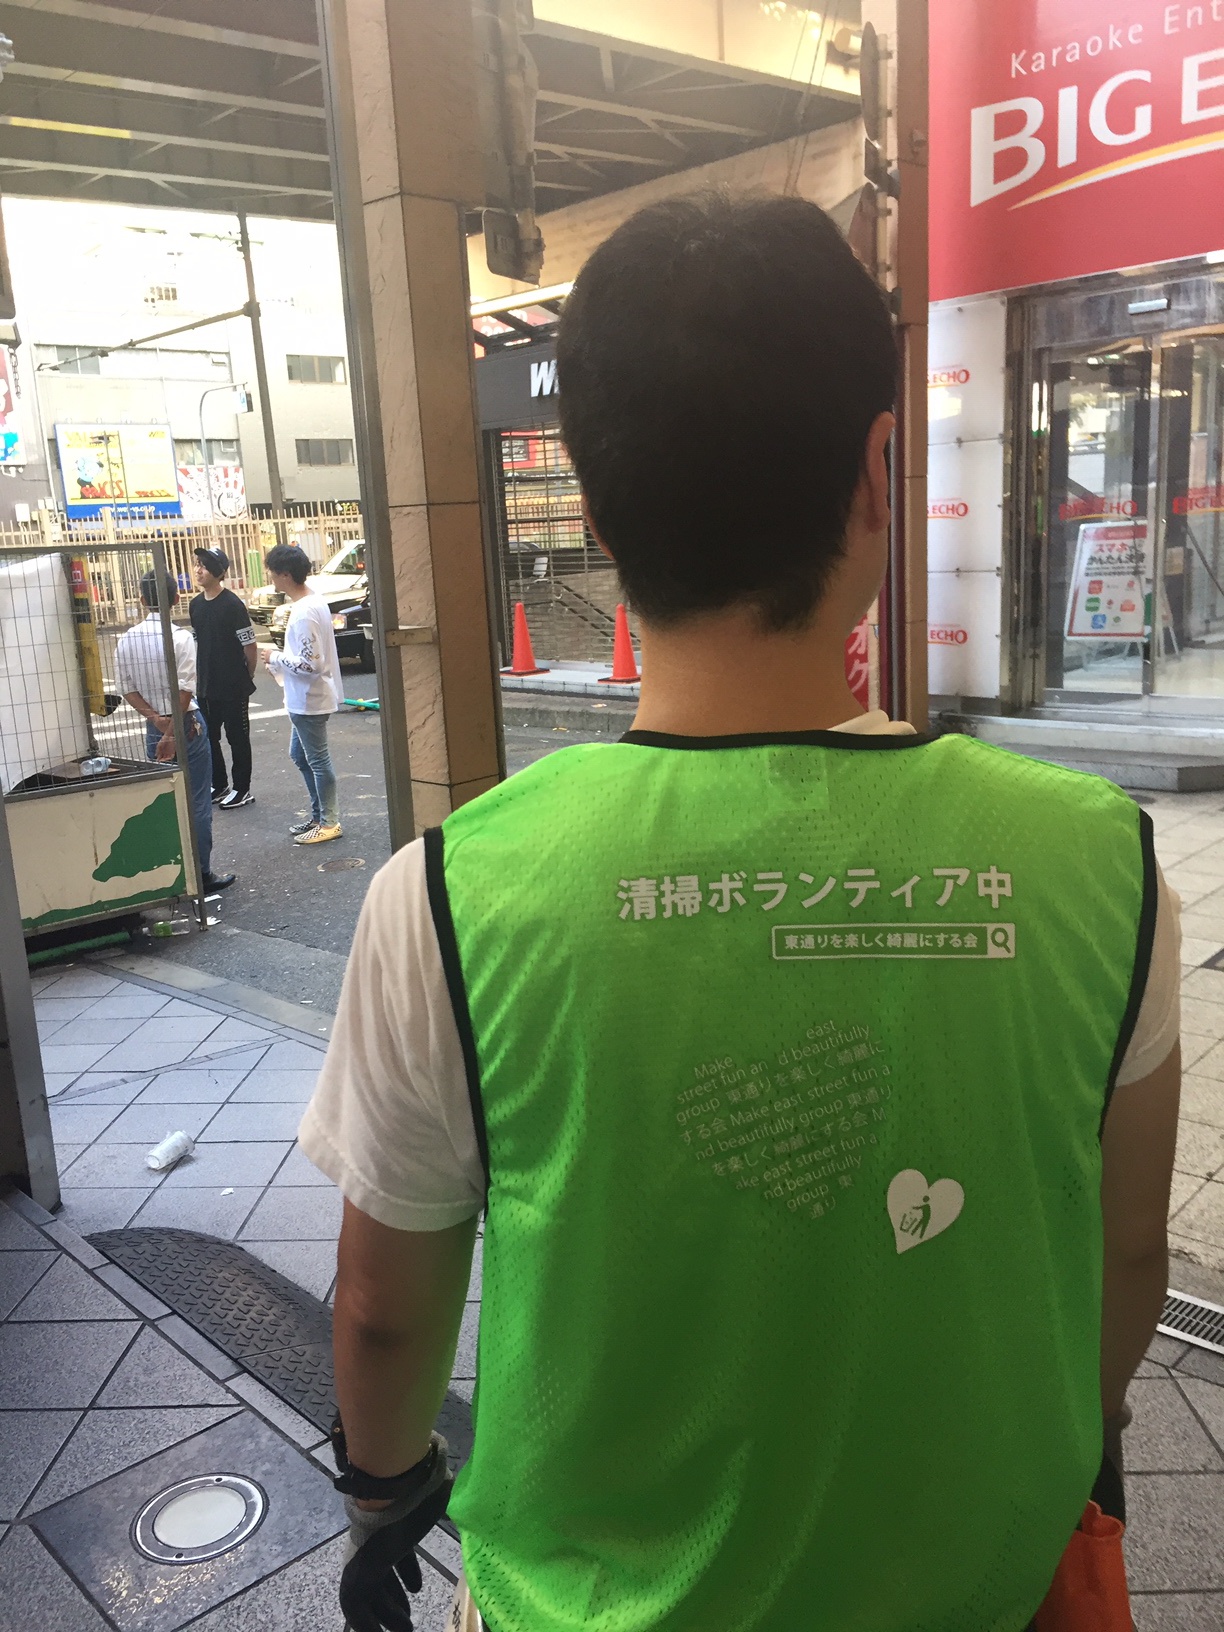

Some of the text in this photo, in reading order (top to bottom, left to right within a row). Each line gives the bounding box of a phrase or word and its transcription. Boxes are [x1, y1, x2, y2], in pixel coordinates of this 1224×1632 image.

[1010, 22, 1144, 79] Karaoke
[969, 68, 1152, 208] BIG
[932, 369, 970, 384] ECHO
[931, 502, 969, 517] ECHO
[930, 629, 968, 645] ECHO
[617, 865, 1013, 920] 清掃ボランティア中
[783, 932, 979, 950] 東通りを楽しく綺麗にする会
[806, 1020, 836, 1039] east
[677, 1079, 718, 1104] street
[720, 1068, 746, 1085] fun
[750, 1061, 768, 1074] an
[791, 1025, 869, 1060] beautifully
[693, 1056, 733, 1079] Make
[676, 1097, 720, 1126] group
[730, 1105, 769, 1127] Make
[773, 1093, 804, 1112] east
[808, 1075, 849, 1101] street
[851, 1067, 878, 1083] fun
[882, 1064, 891, 1076] a
[696, 1143, 715, 1160] nd
[717, 1117, 794, 1152] beautifully
[799, 1099, 844, 1127] group
[735, 1175, 760, 1191] ake
[763, 1160, 792, 1181] east
[795, 1143, 838, 1168] street
[840, 1135, 866, 1151] fun
[764, 1154, 861, 1200] nd beautifully
[786, 1183, 829, 1212] group
